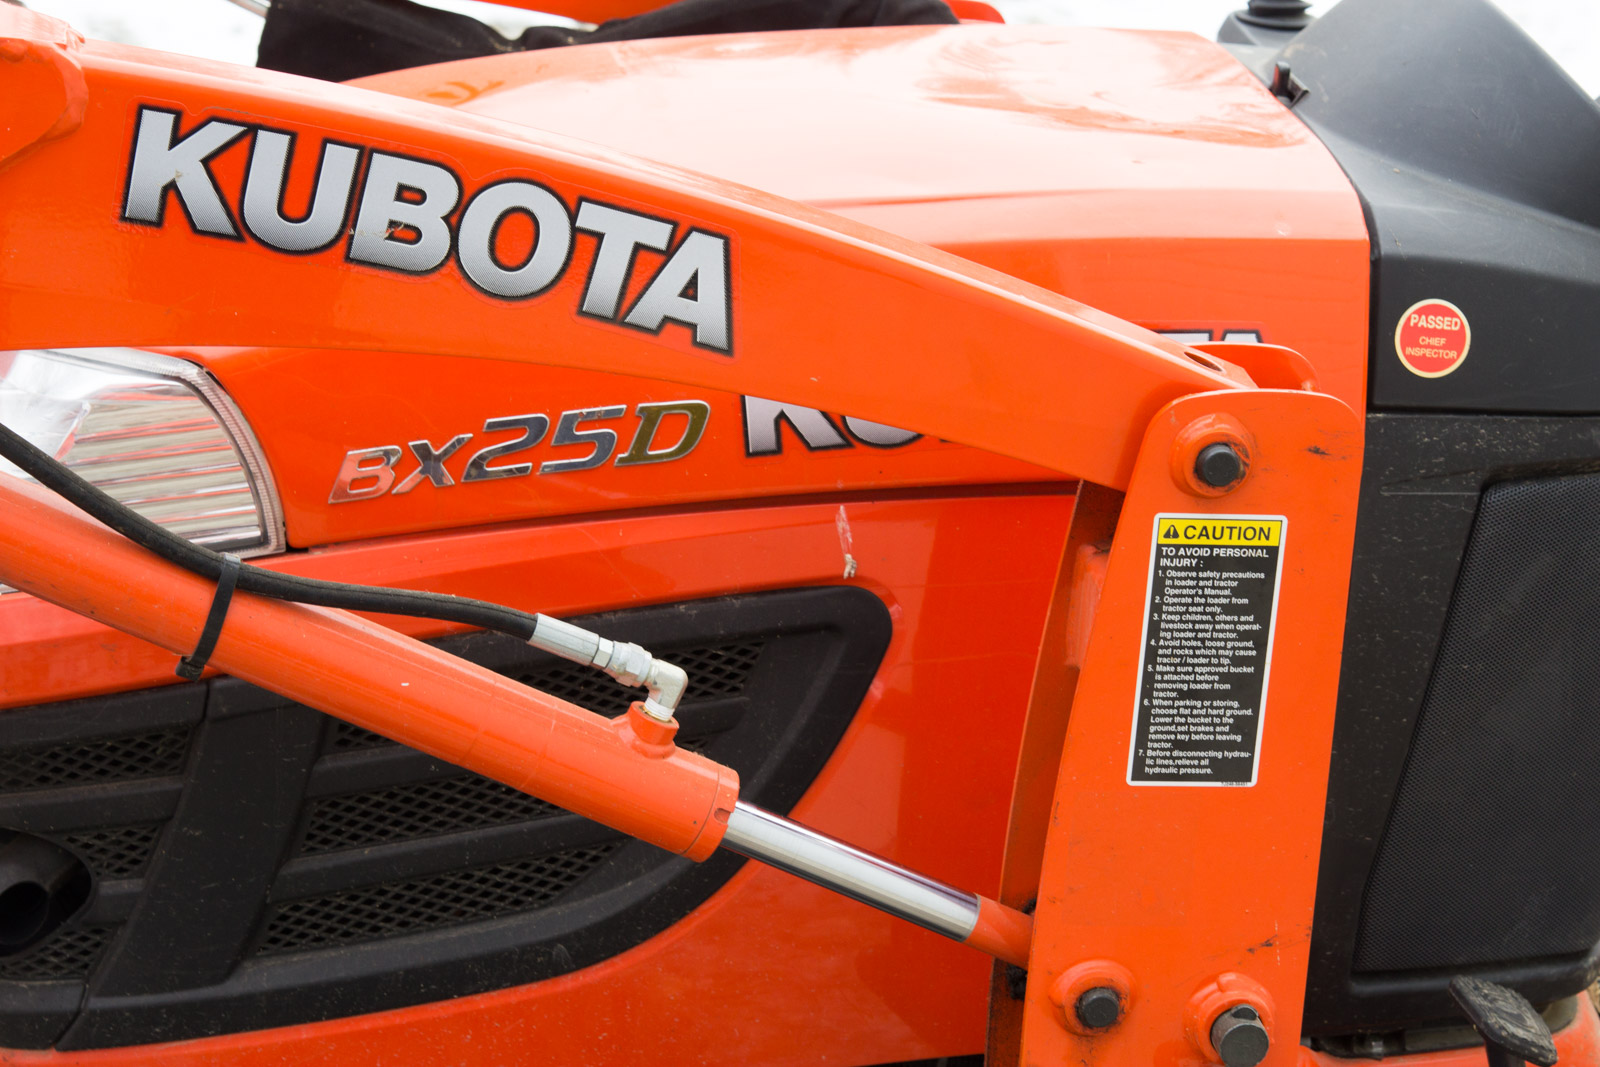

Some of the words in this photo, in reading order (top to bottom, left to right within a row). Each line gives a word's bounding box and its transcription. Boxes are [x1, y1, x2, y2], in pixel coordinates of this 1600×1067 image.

[121, 104, 735, 357] KUBOTA
[1410, 314, 1461, 331] PASSED
[1419, 336, 1446, 346] CHIEF
[1405, 347, 1457, 359] INSPECTOR
[328, 400, 711, 505] BX25D
[1184, 525, 1271, 541] CAUTION
[1162, 547, 1175, 556] TO
[1178, 548, 1211, 557] AVOID
[1213, 549, 1269, 558] PERSONAL
[1160, 559, 1198, 567] INJURY
[1199, 571, 1220, 579] safety
[1222, 572, 1265, 580] precautions
[1165, 588, 1202, 596] Operator's
[1164, 597, 1192, 605] Operate
[1206, 606, 1223, 614] only.
[1162, 614, 1180, 622] Keep
[1160, 631, 1171, 639] ing
[1194, 666, 1228, 674] approved
[1154, 683, 1188, 691] removing
[1174, 700, 1202, 708] parking
[1177, 734, 1190, 742] key
[1216, 734, 1242, 742] leaving
[1172, 751, 1222, 759] disconnecting
[1224, 751, 1251, 759] hydrau-
[1145, 767, 1178, 775] hydraulic
